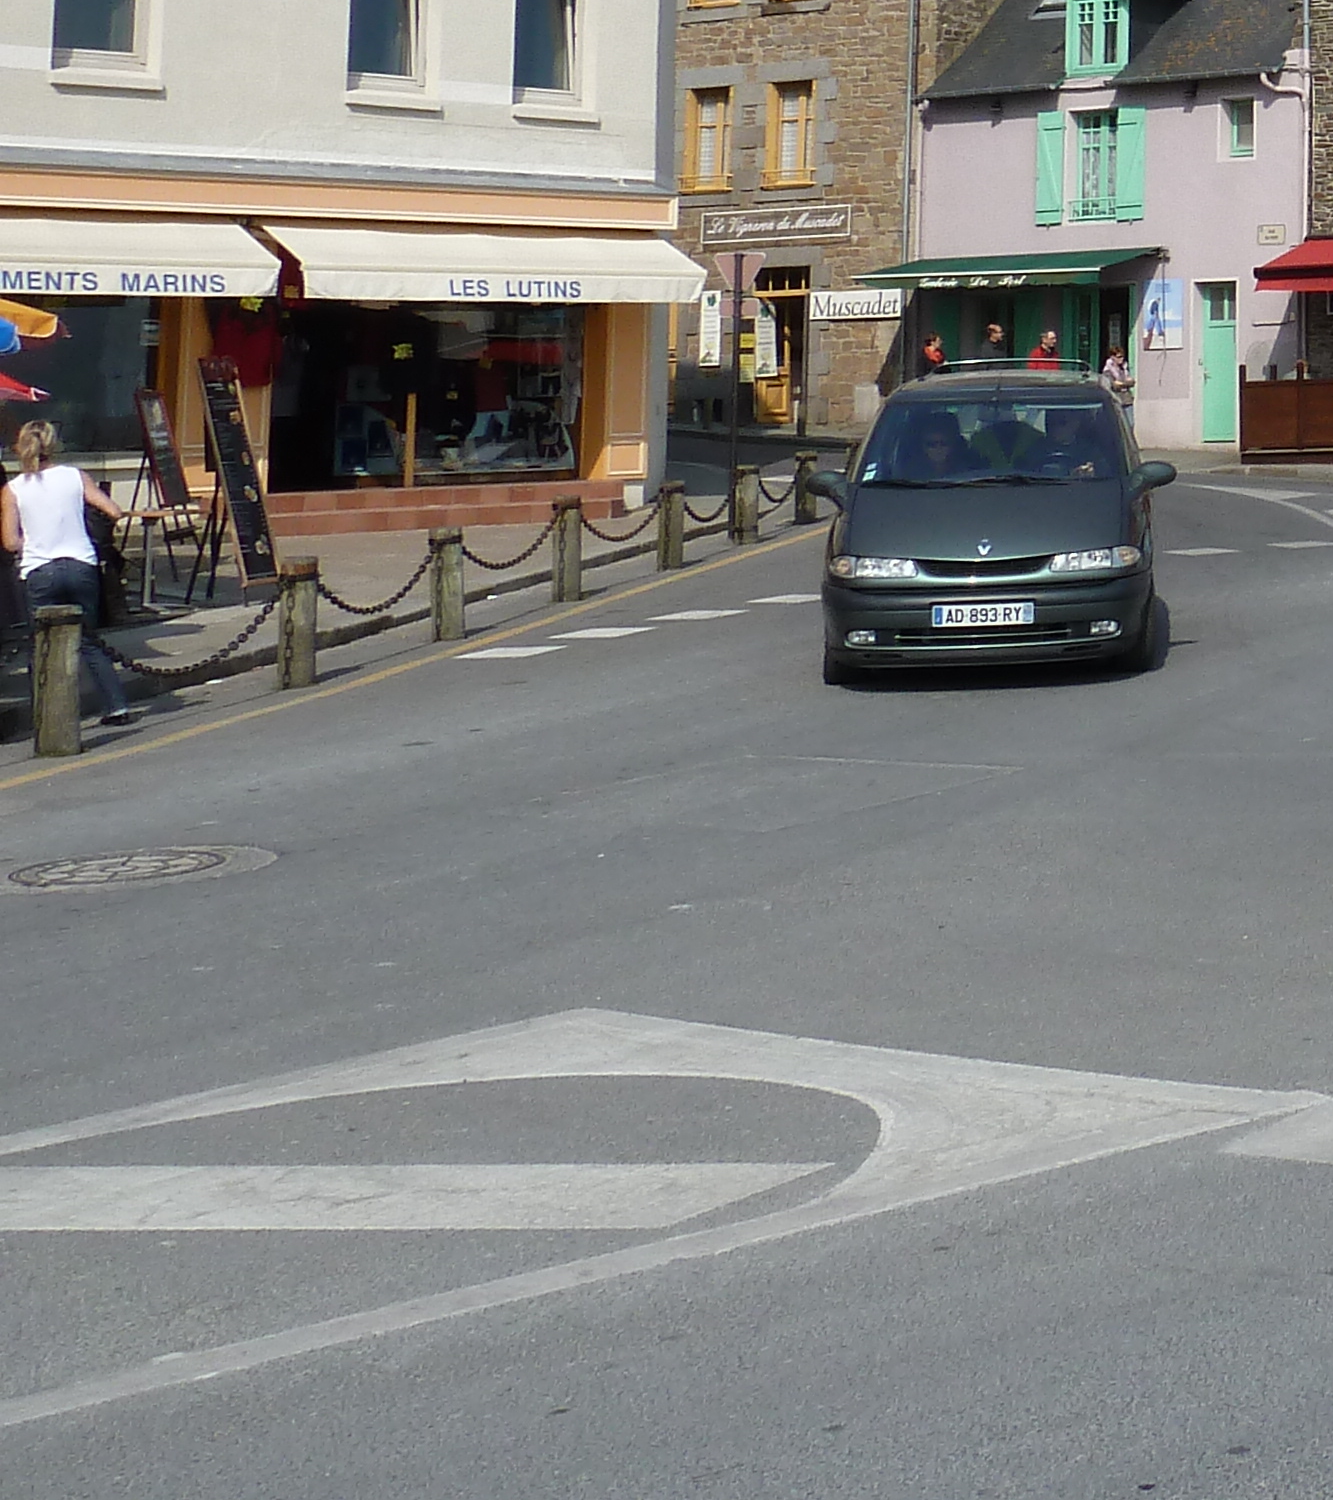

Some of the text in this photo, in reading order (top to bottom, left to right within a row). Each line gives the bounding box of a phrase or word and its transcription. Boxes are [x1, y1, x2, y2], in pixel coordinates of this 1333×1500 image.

[790, 212, 845, 230] Muscadet
[1, 270, 98, 292] MENTS
[120, 273, 226, 293] MARINS
[449, 279, 582, 298] LES LUTINS
[812, 292, 899, 317] Muscadet
